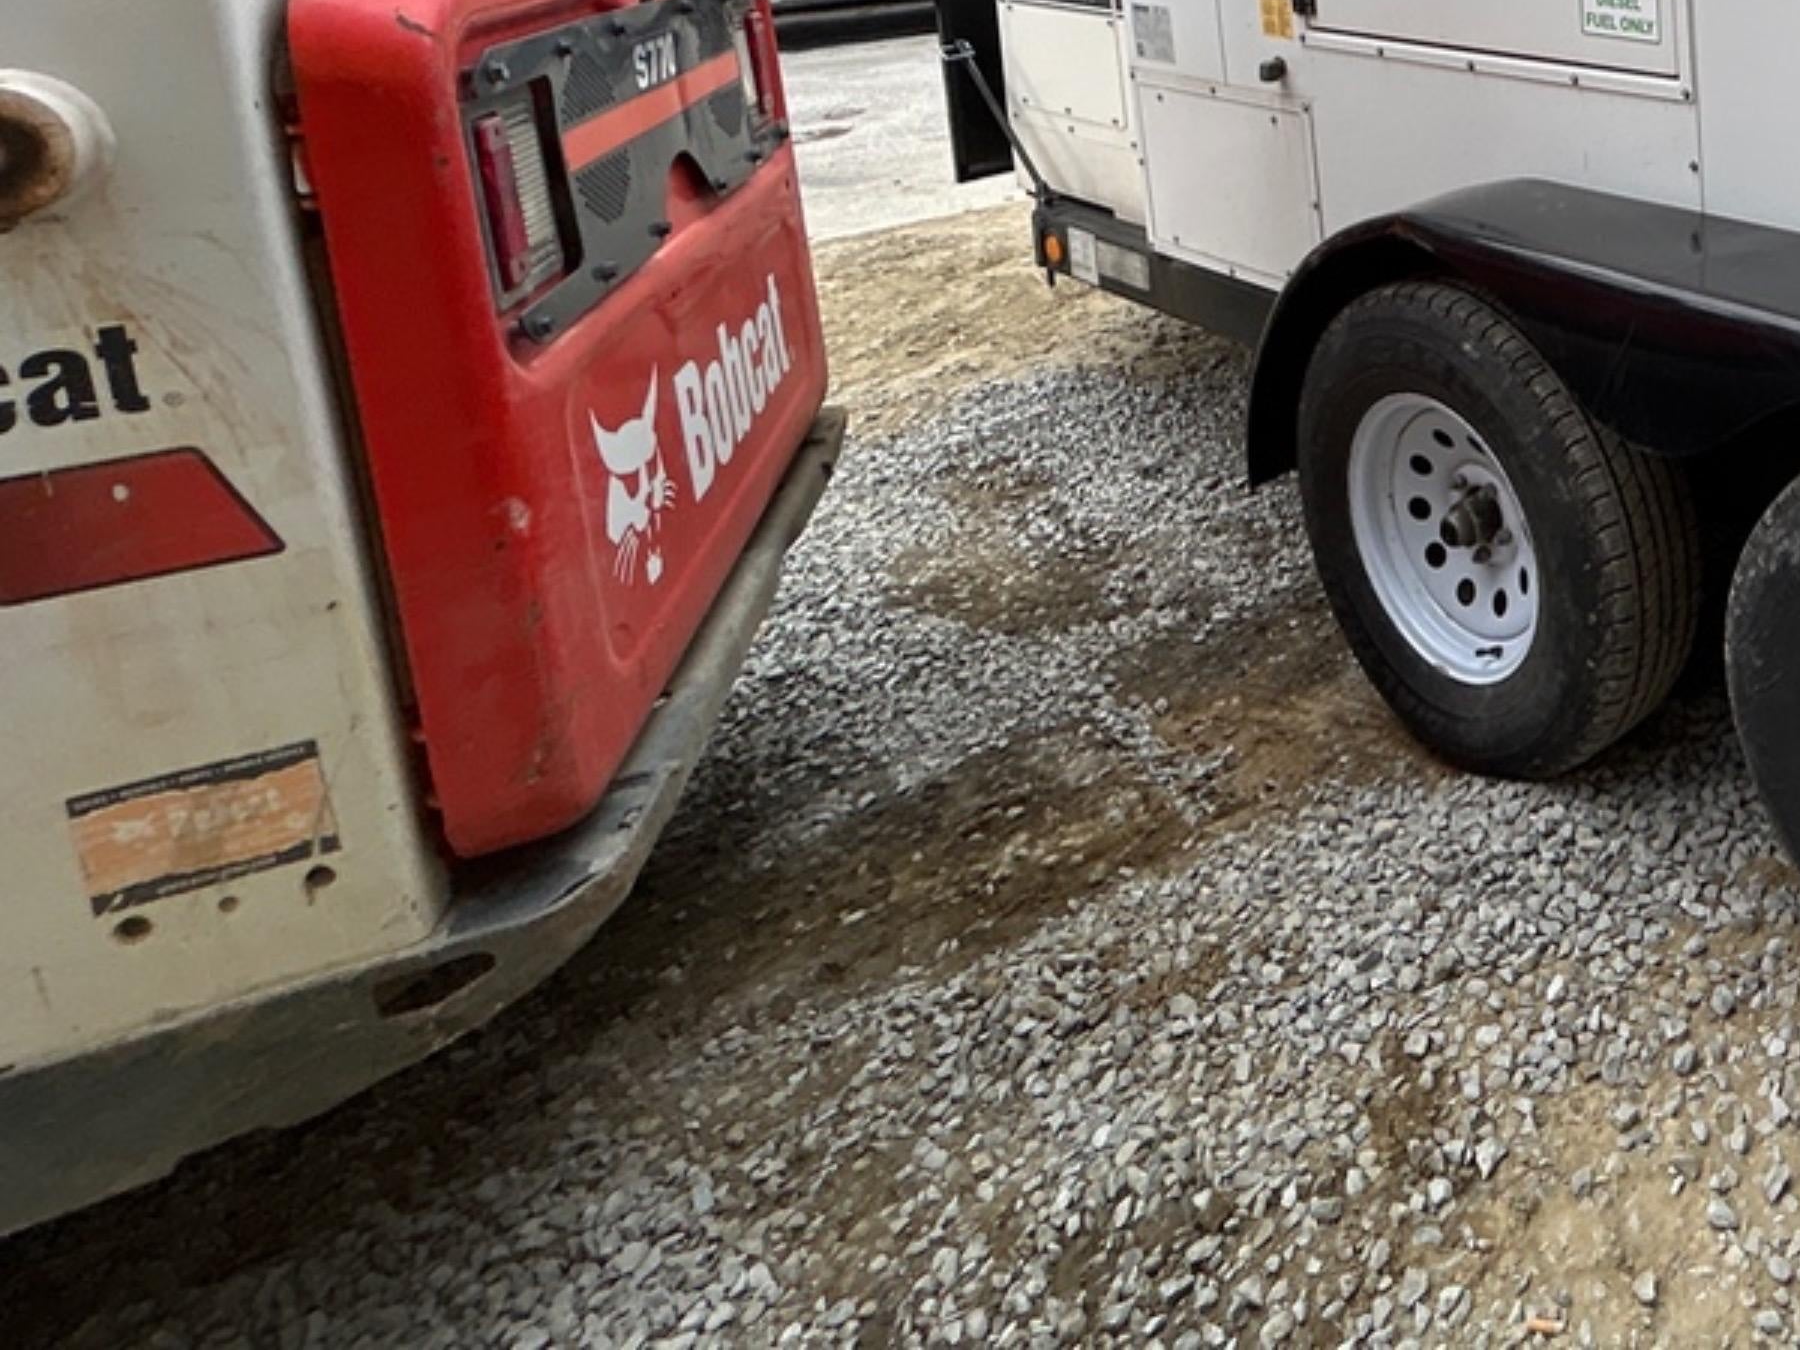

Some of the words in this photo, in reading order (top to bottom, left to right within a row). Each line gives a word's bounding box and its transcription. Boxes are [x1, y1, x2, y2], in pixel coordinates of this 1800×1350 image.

[1586, 11, 1618, 31] FUEL
[1620, 15, 1655, 34] ONLY
[673, 272, 791, 504] Bobcat
